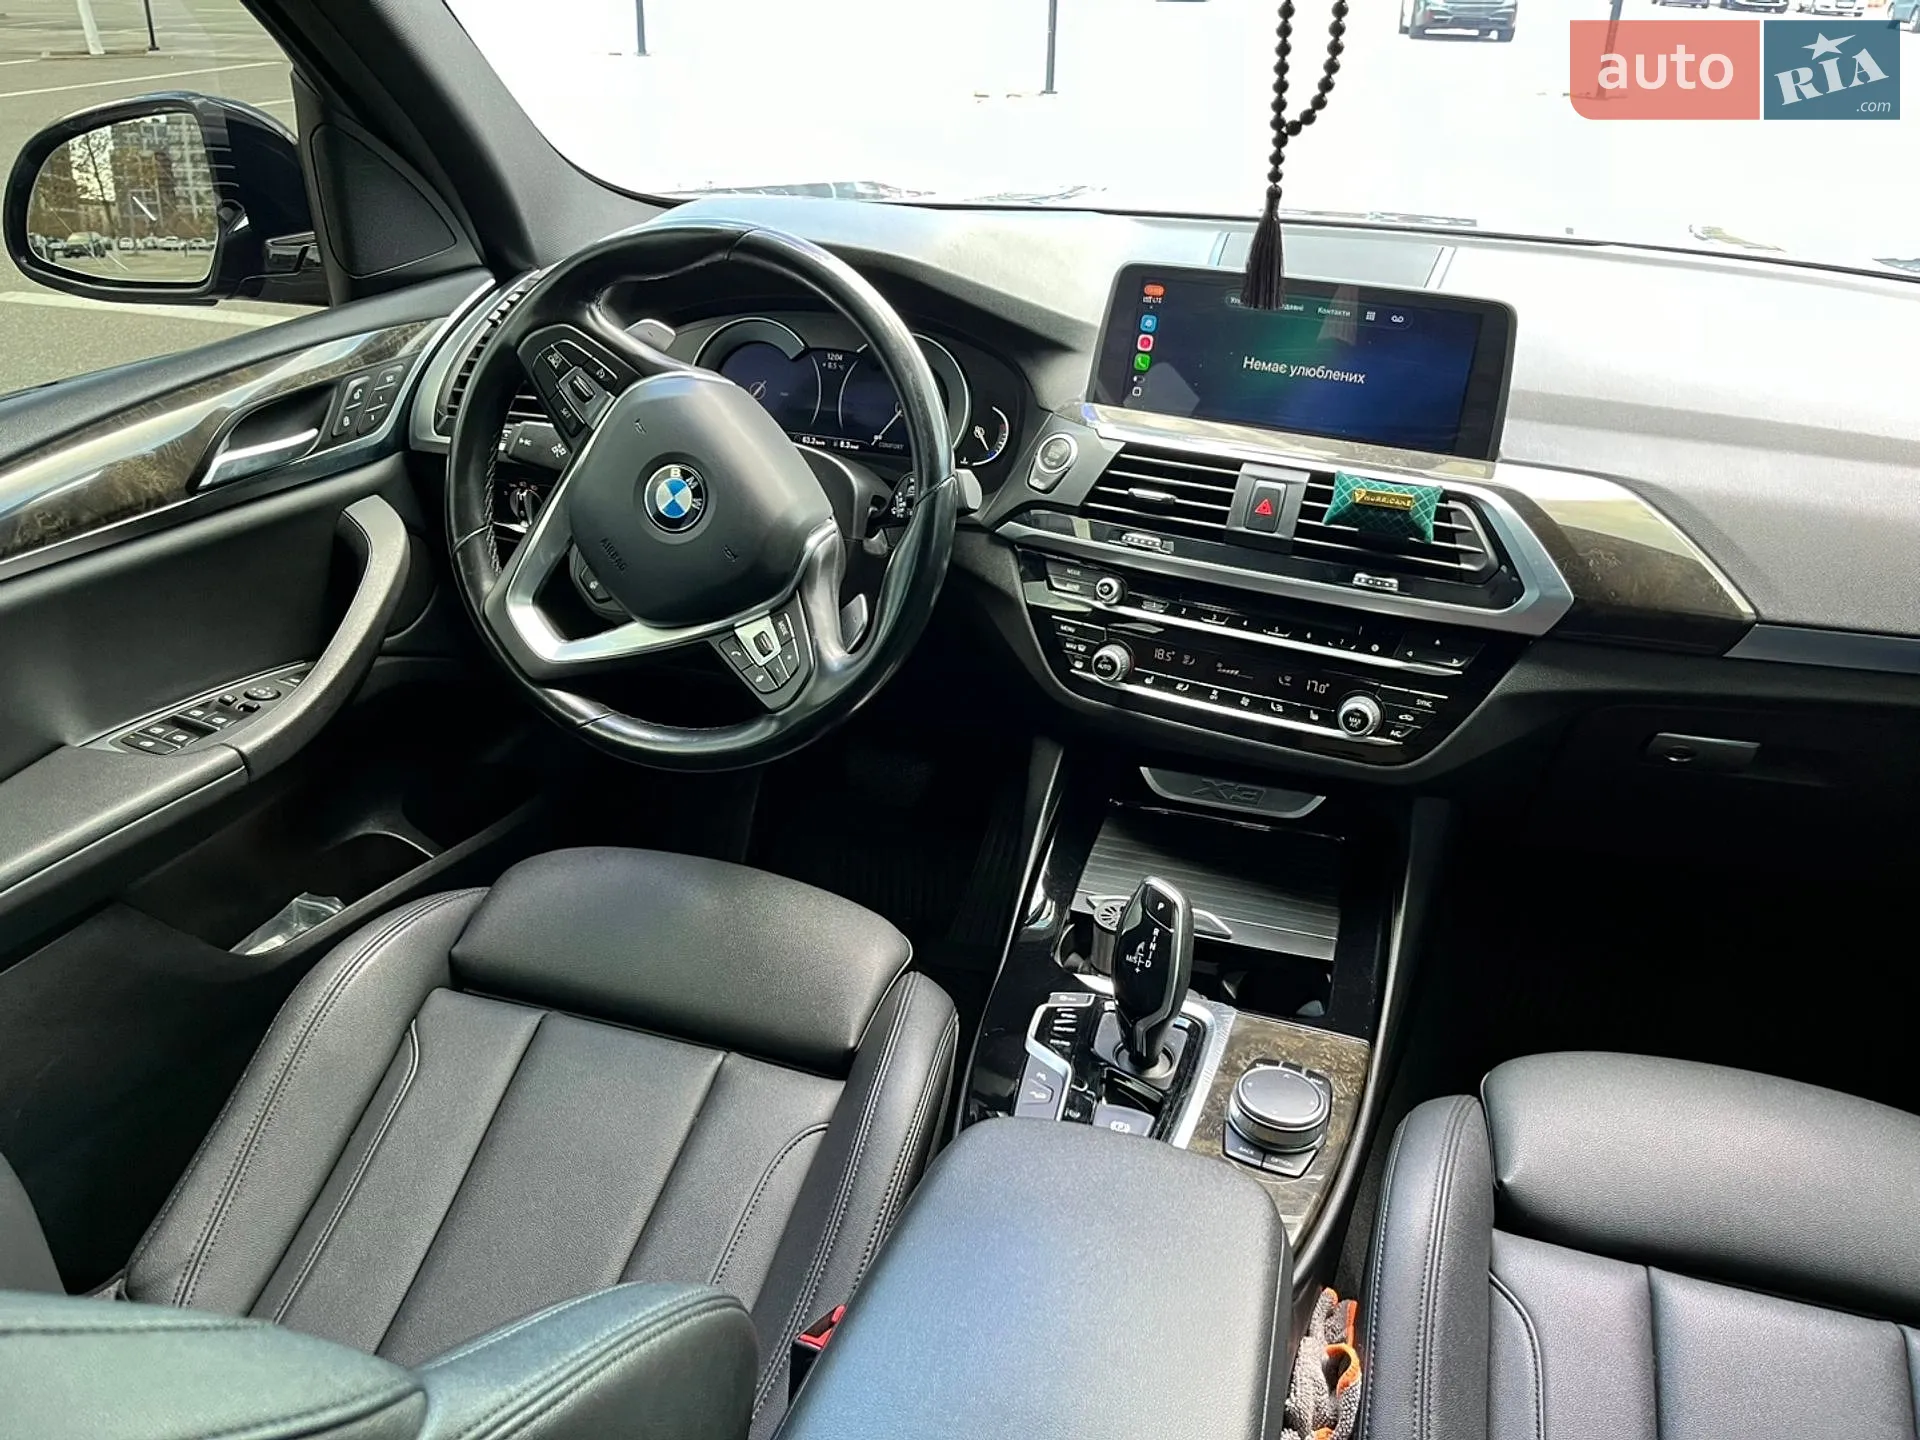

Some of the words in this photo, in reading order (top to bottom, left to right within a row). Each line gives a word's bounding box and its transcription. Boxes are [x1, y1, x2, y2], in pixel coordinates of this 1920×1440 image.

[1317, 306, 1351, 317] Контакти
[1243, 355, 1287, 374] Немає
[1289, 365, 1366, 384] улюблених
[670, 467, 702, 510] BMW
[1191, 778, 1267, 808] X3
[1157, 902, 1165, 910] P
[1149, 942, 1157, 951] N
[1144, 960, 1152, 968] D
